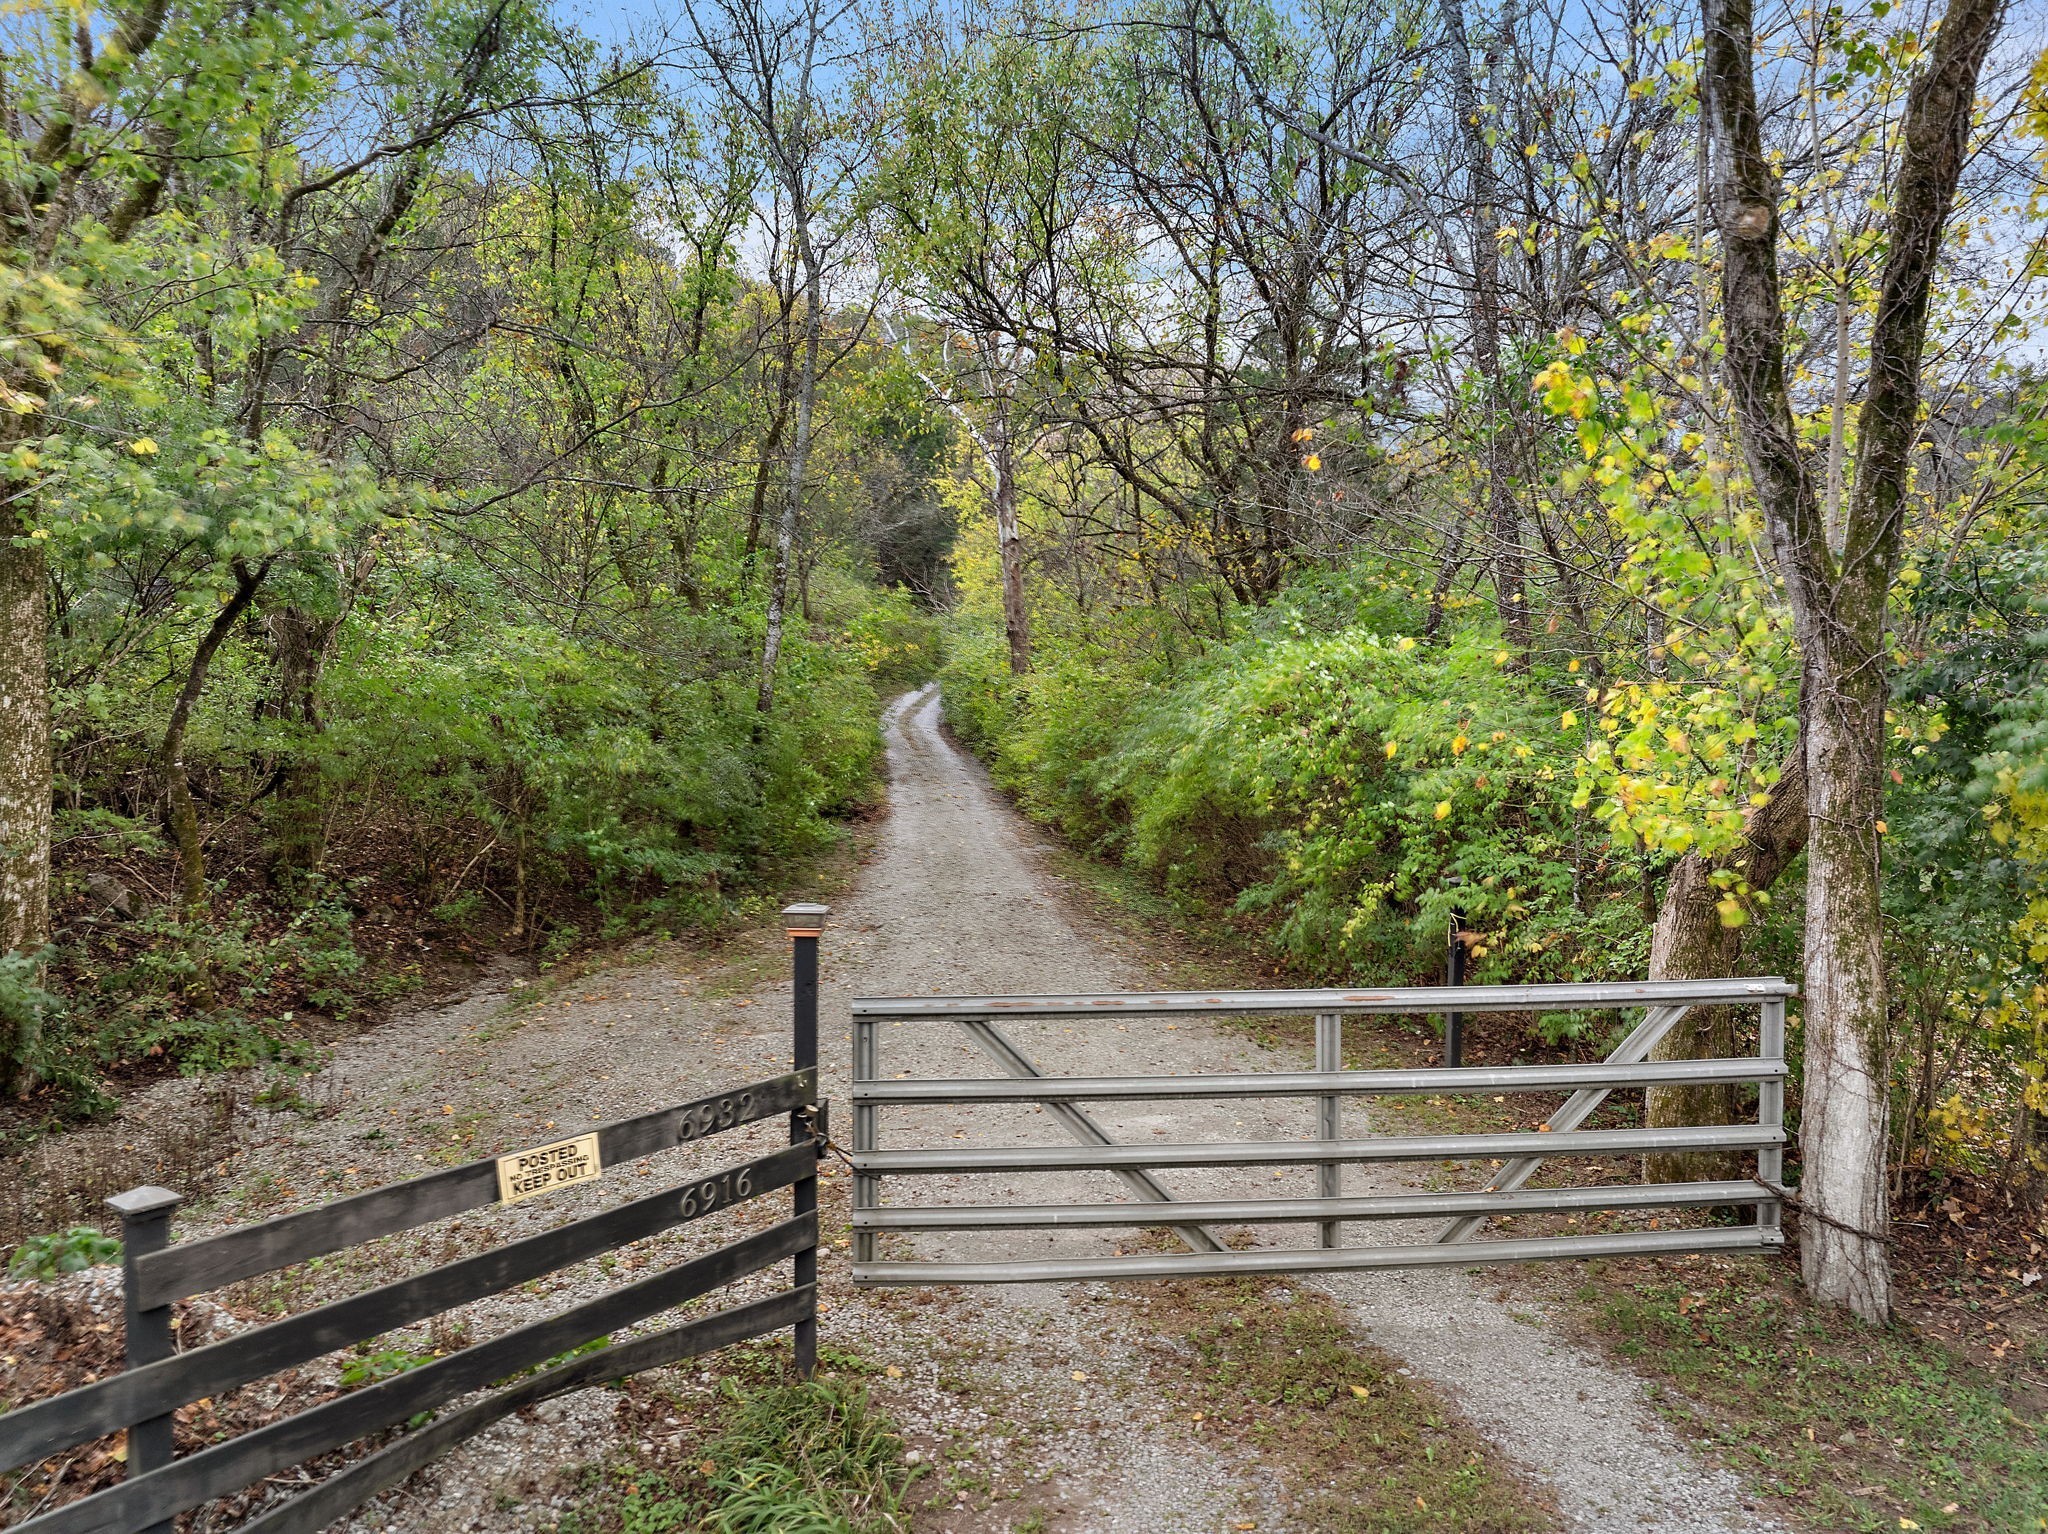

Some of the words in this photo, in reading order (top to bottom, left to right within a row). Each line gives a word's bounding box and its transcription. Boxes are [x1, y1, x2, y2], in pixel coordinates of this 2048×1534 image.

[680, 1093, 754, 1139] 6932
[509, 1173, 523, 1181] NO
[525, 1154, 589, 1177] TRESPASSING
[519, 1144, 578, 1171] POSTED
[513, 1173, 551, 1195] KEEP
[556, 1163, 587, 1181] OUT
[680, 1168, 752, 1218] 6916
